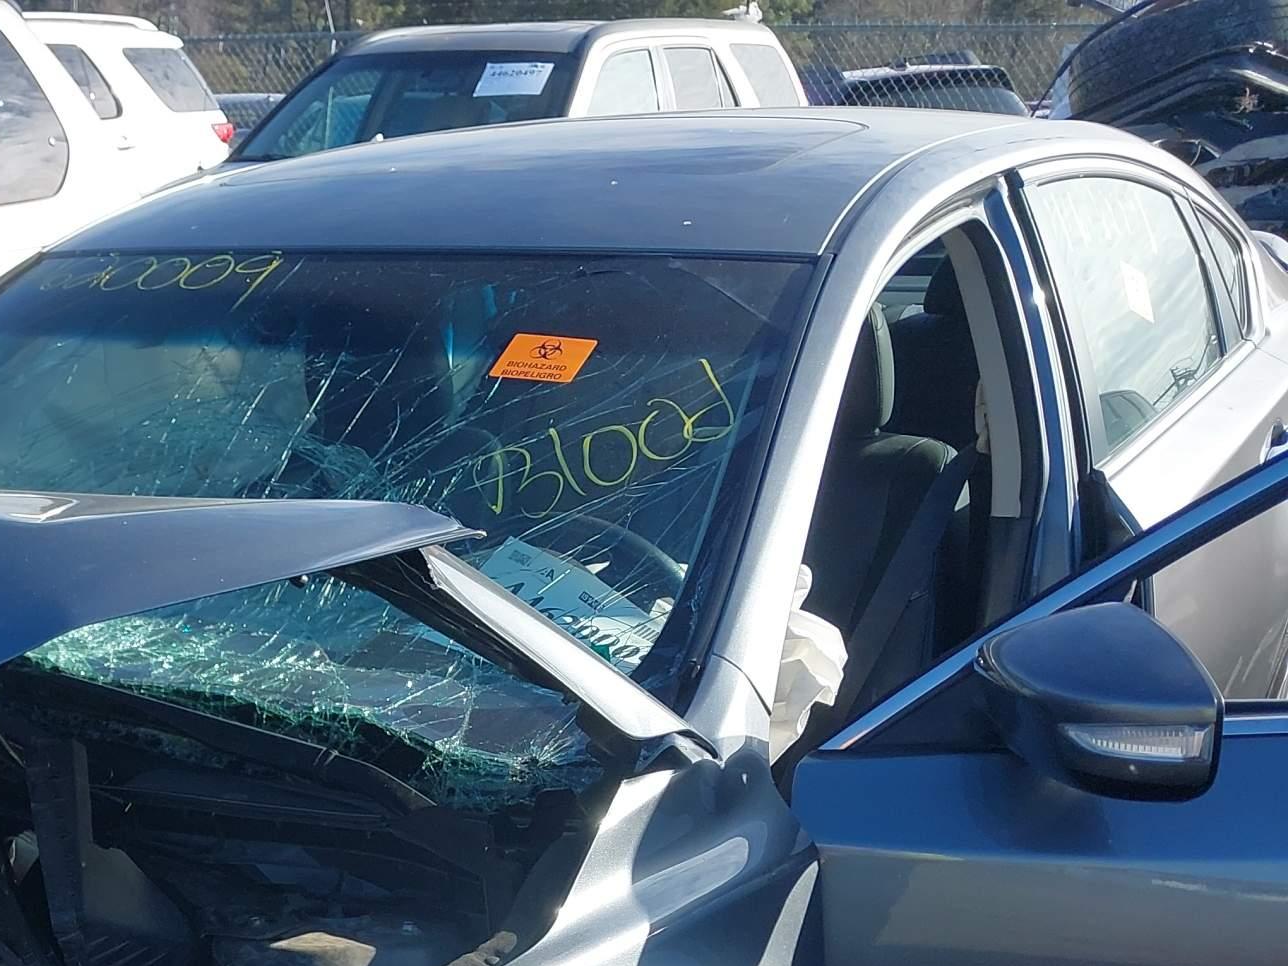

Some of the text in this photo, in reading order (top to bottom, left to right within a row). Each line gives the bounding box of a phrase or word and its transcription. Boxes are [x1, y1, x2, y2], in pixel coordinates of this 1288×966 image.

[506, 360, 567, 372] BIOHAZARD
[500, 369, 562, 380] BIOPELIGRO
[473, 358, 735, 519] Blood
